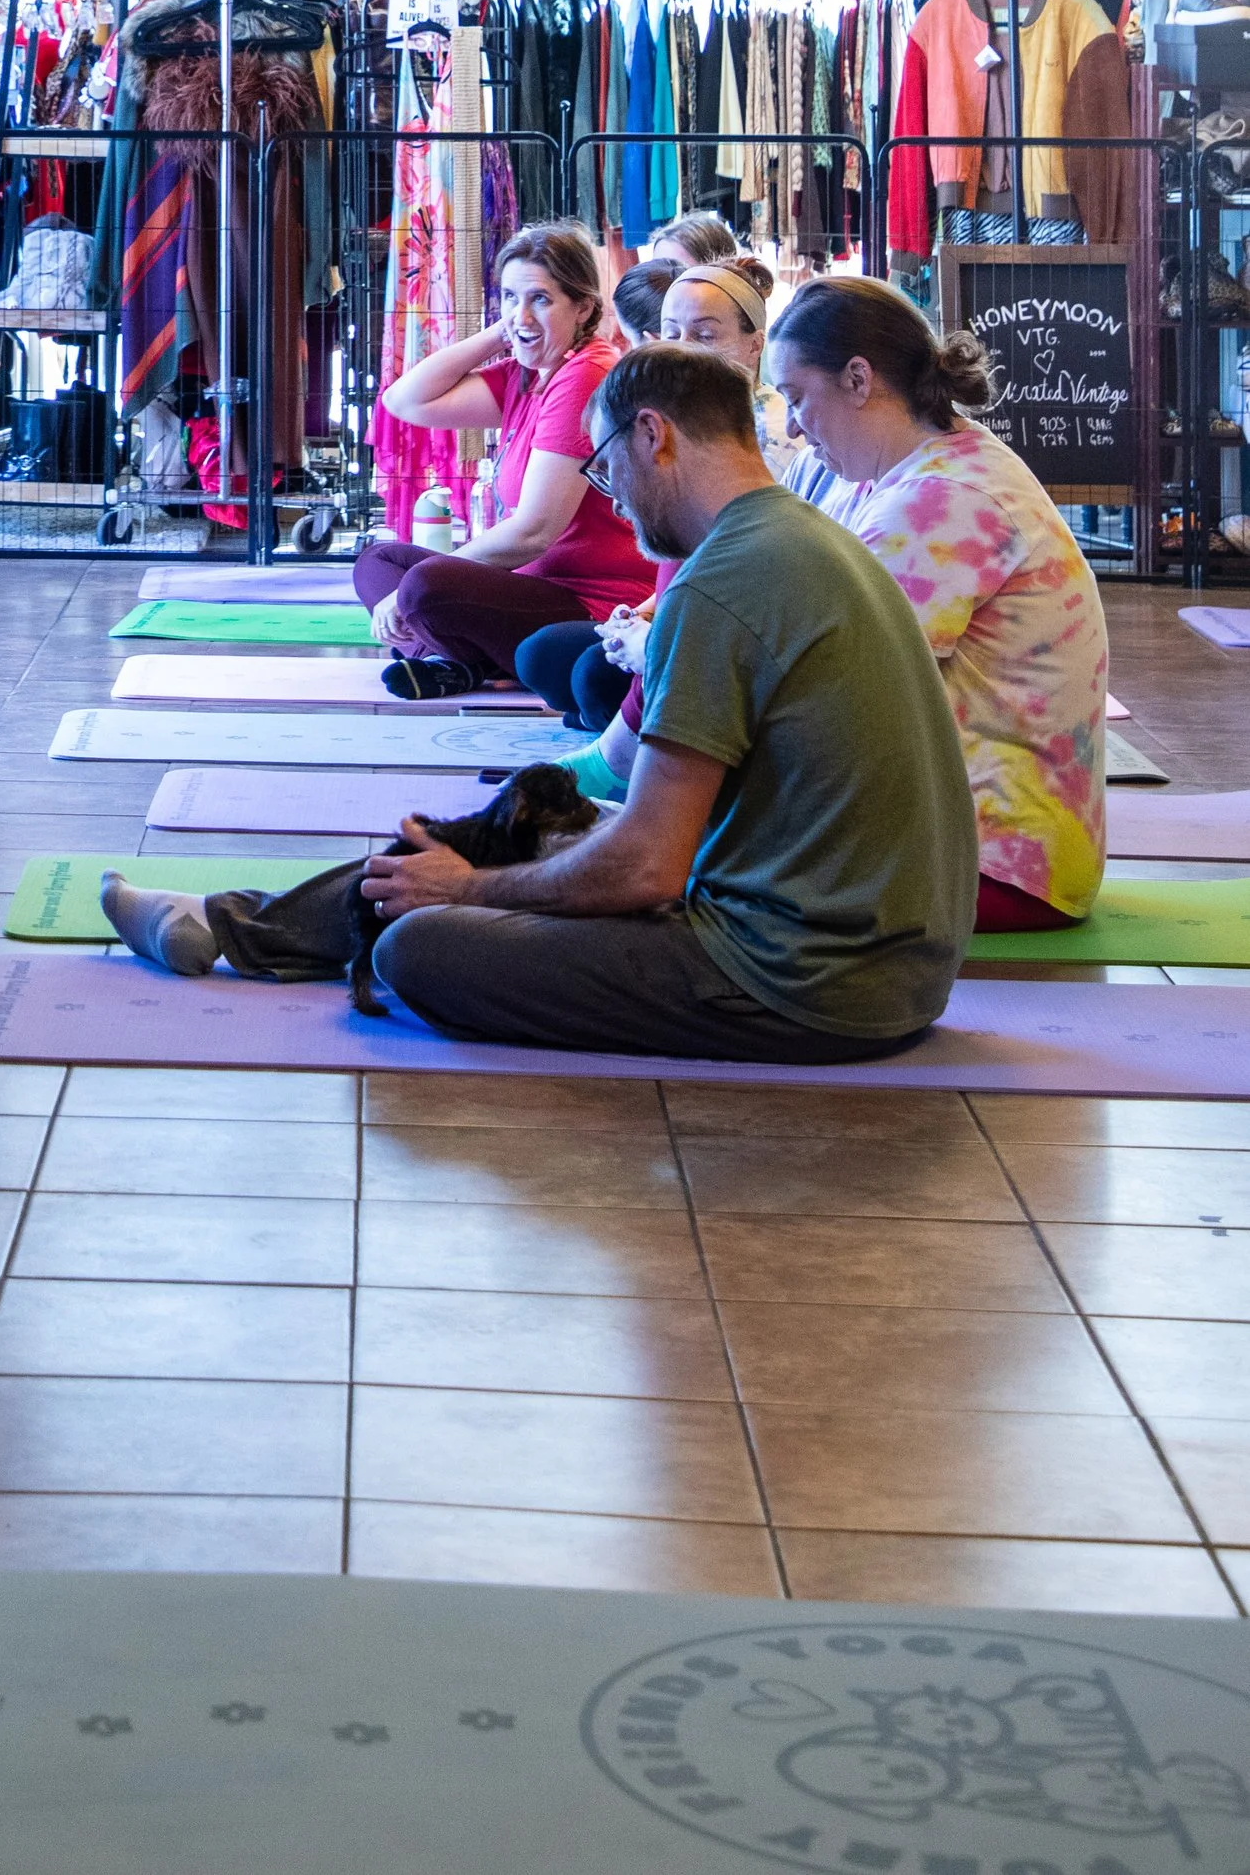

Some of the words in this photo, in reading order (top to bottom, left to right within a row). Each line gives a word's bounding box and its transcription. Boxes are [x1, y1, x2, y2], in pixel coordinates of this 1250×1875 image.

[409, 0, 416, 8] IS
[433, 5, 441, 13] IS
[969, 298, 1123, 336] HONEYMOON
[1017, 328, 1060, 346] VTG.
[985, 365, 1068, 412] Curated
[1061, 371, 1130, 414] Vintage
[982, 417, 1011, 430] HAND
[1087, 417, 1112, 430] RARE
[1037, 433, 1068, 447] Y2K
[1089, 433, 1115, 446] GEMS
[754, 1634, 1027, 1666] YOGA
